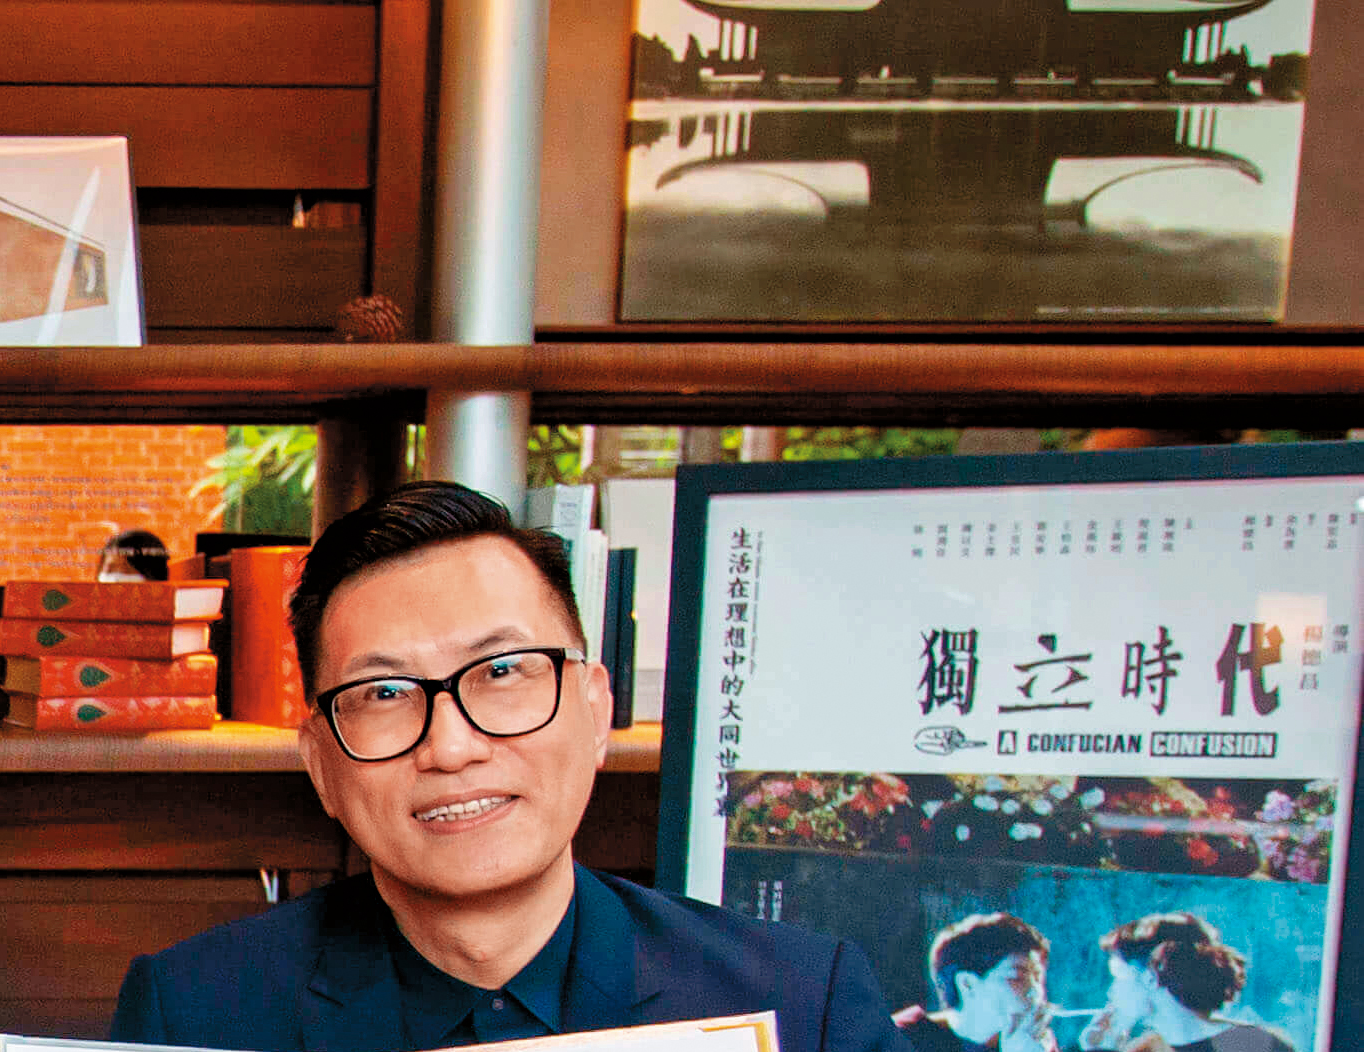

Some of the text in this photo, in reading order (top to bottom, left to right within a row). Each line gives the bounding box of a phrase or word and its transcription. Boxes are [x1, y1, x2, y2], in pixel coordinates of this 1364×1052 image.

[917, 622, 1284, 717] 獨立時代
[998, 731, 1275, 757] A CONFUCIAN CONFUSION
